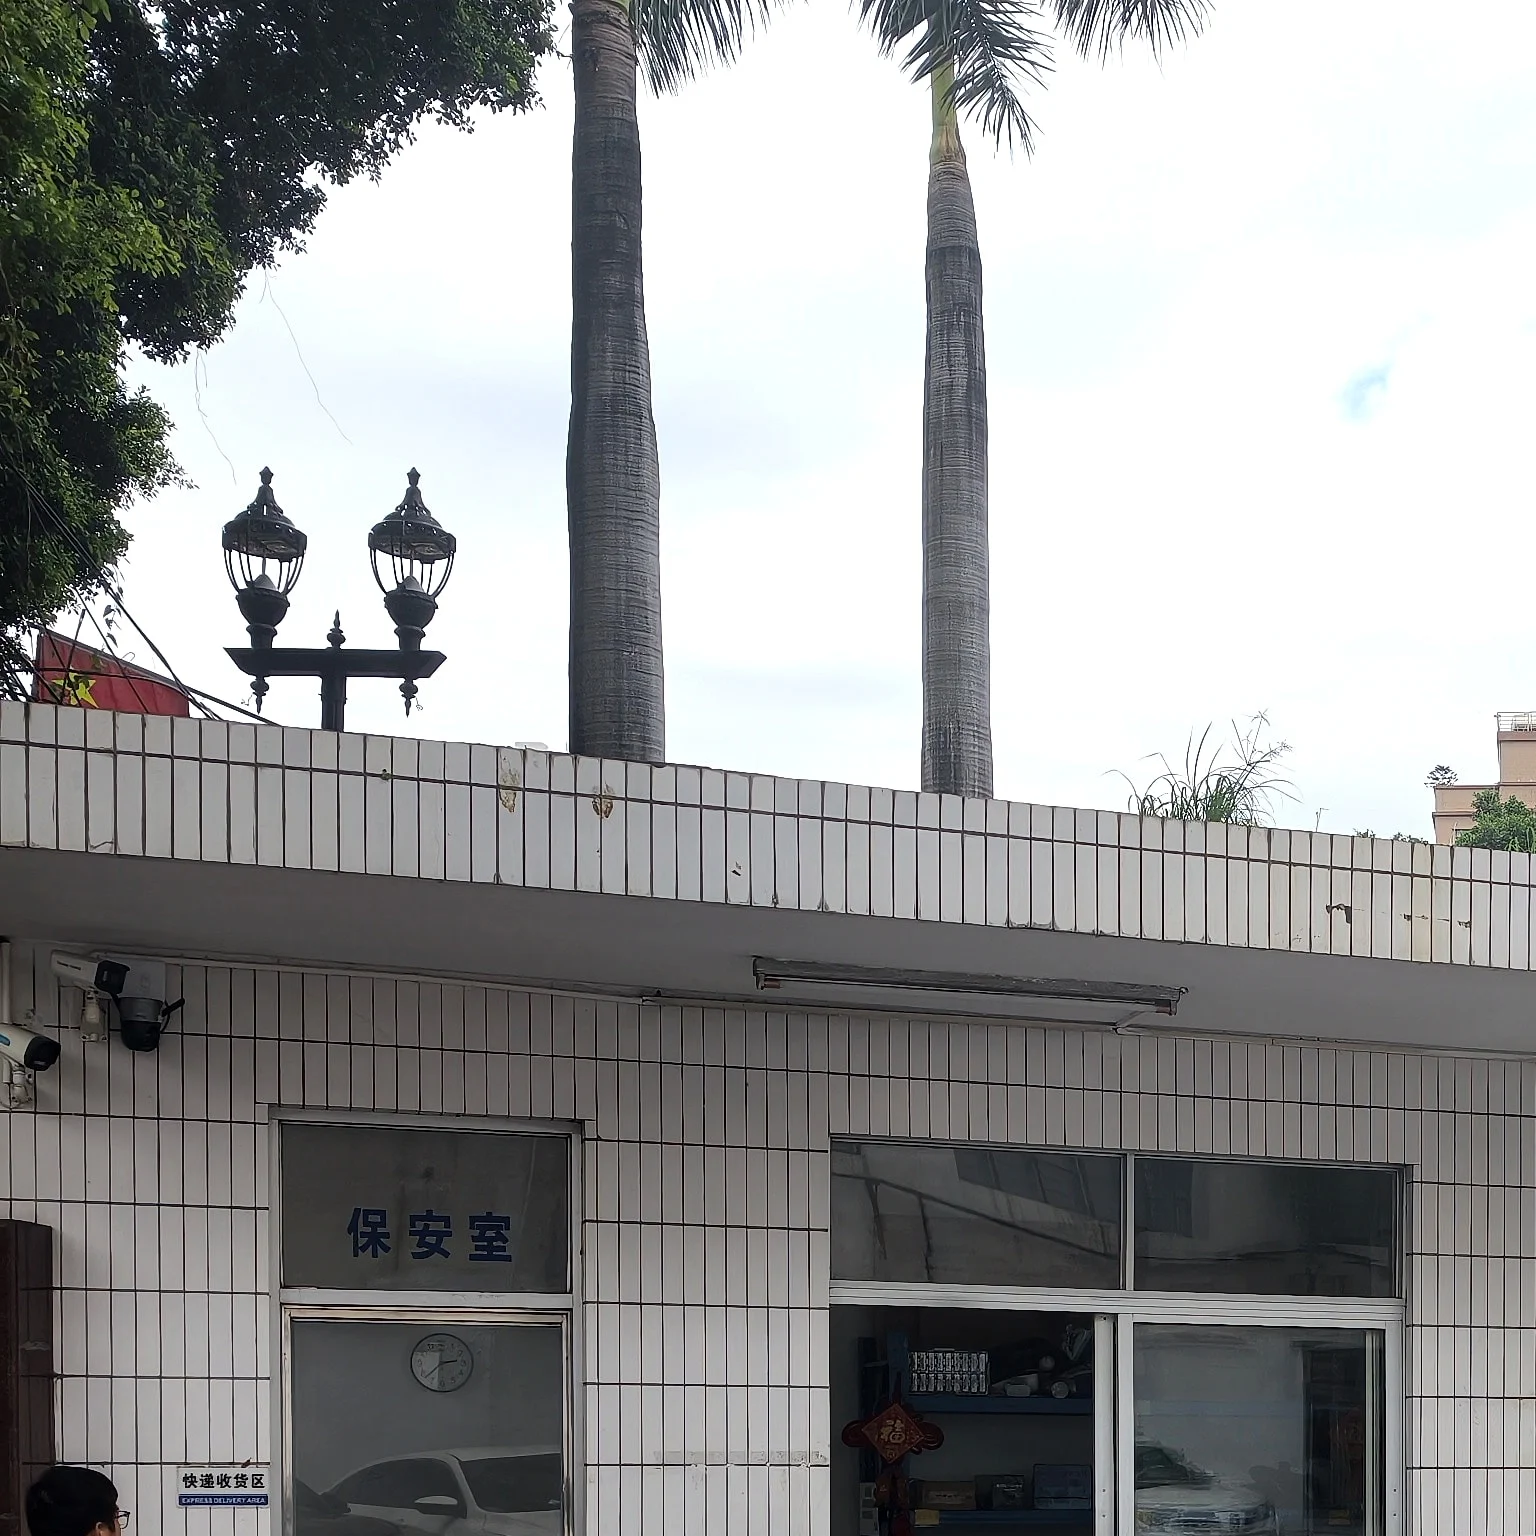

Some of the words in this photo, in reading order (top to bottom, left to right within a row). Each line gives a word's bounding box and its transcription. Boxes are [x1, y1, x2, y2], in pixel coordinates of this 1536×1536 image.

[347, 1207, 513, 1263] 保安室
[880, 1419, 906, 1444] 福
[182, 1472, 266, 1489] 快递收货区
